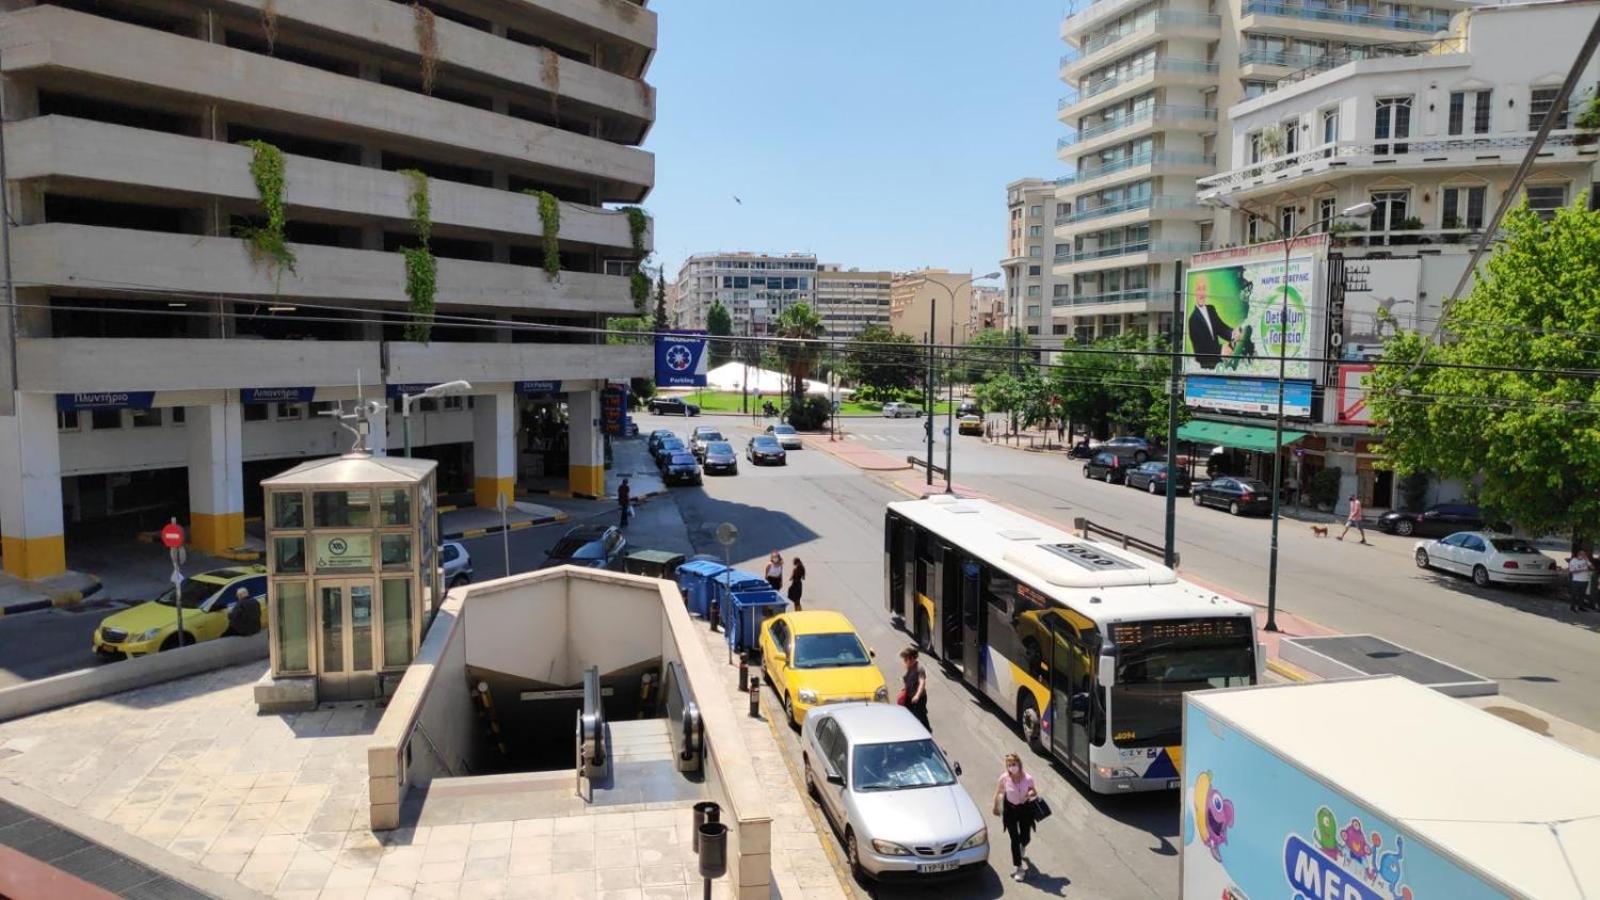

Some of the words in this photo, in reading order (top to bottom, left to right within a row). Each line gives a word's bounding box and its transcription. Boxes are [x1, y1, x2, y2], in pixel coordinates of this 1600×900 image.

[1282, 272, 1309, 284] ΣΦΕΡΛΗΣ
[669, 377, 695, 385] Parking
[74, 391, 129, 406] Πλυντήριο
